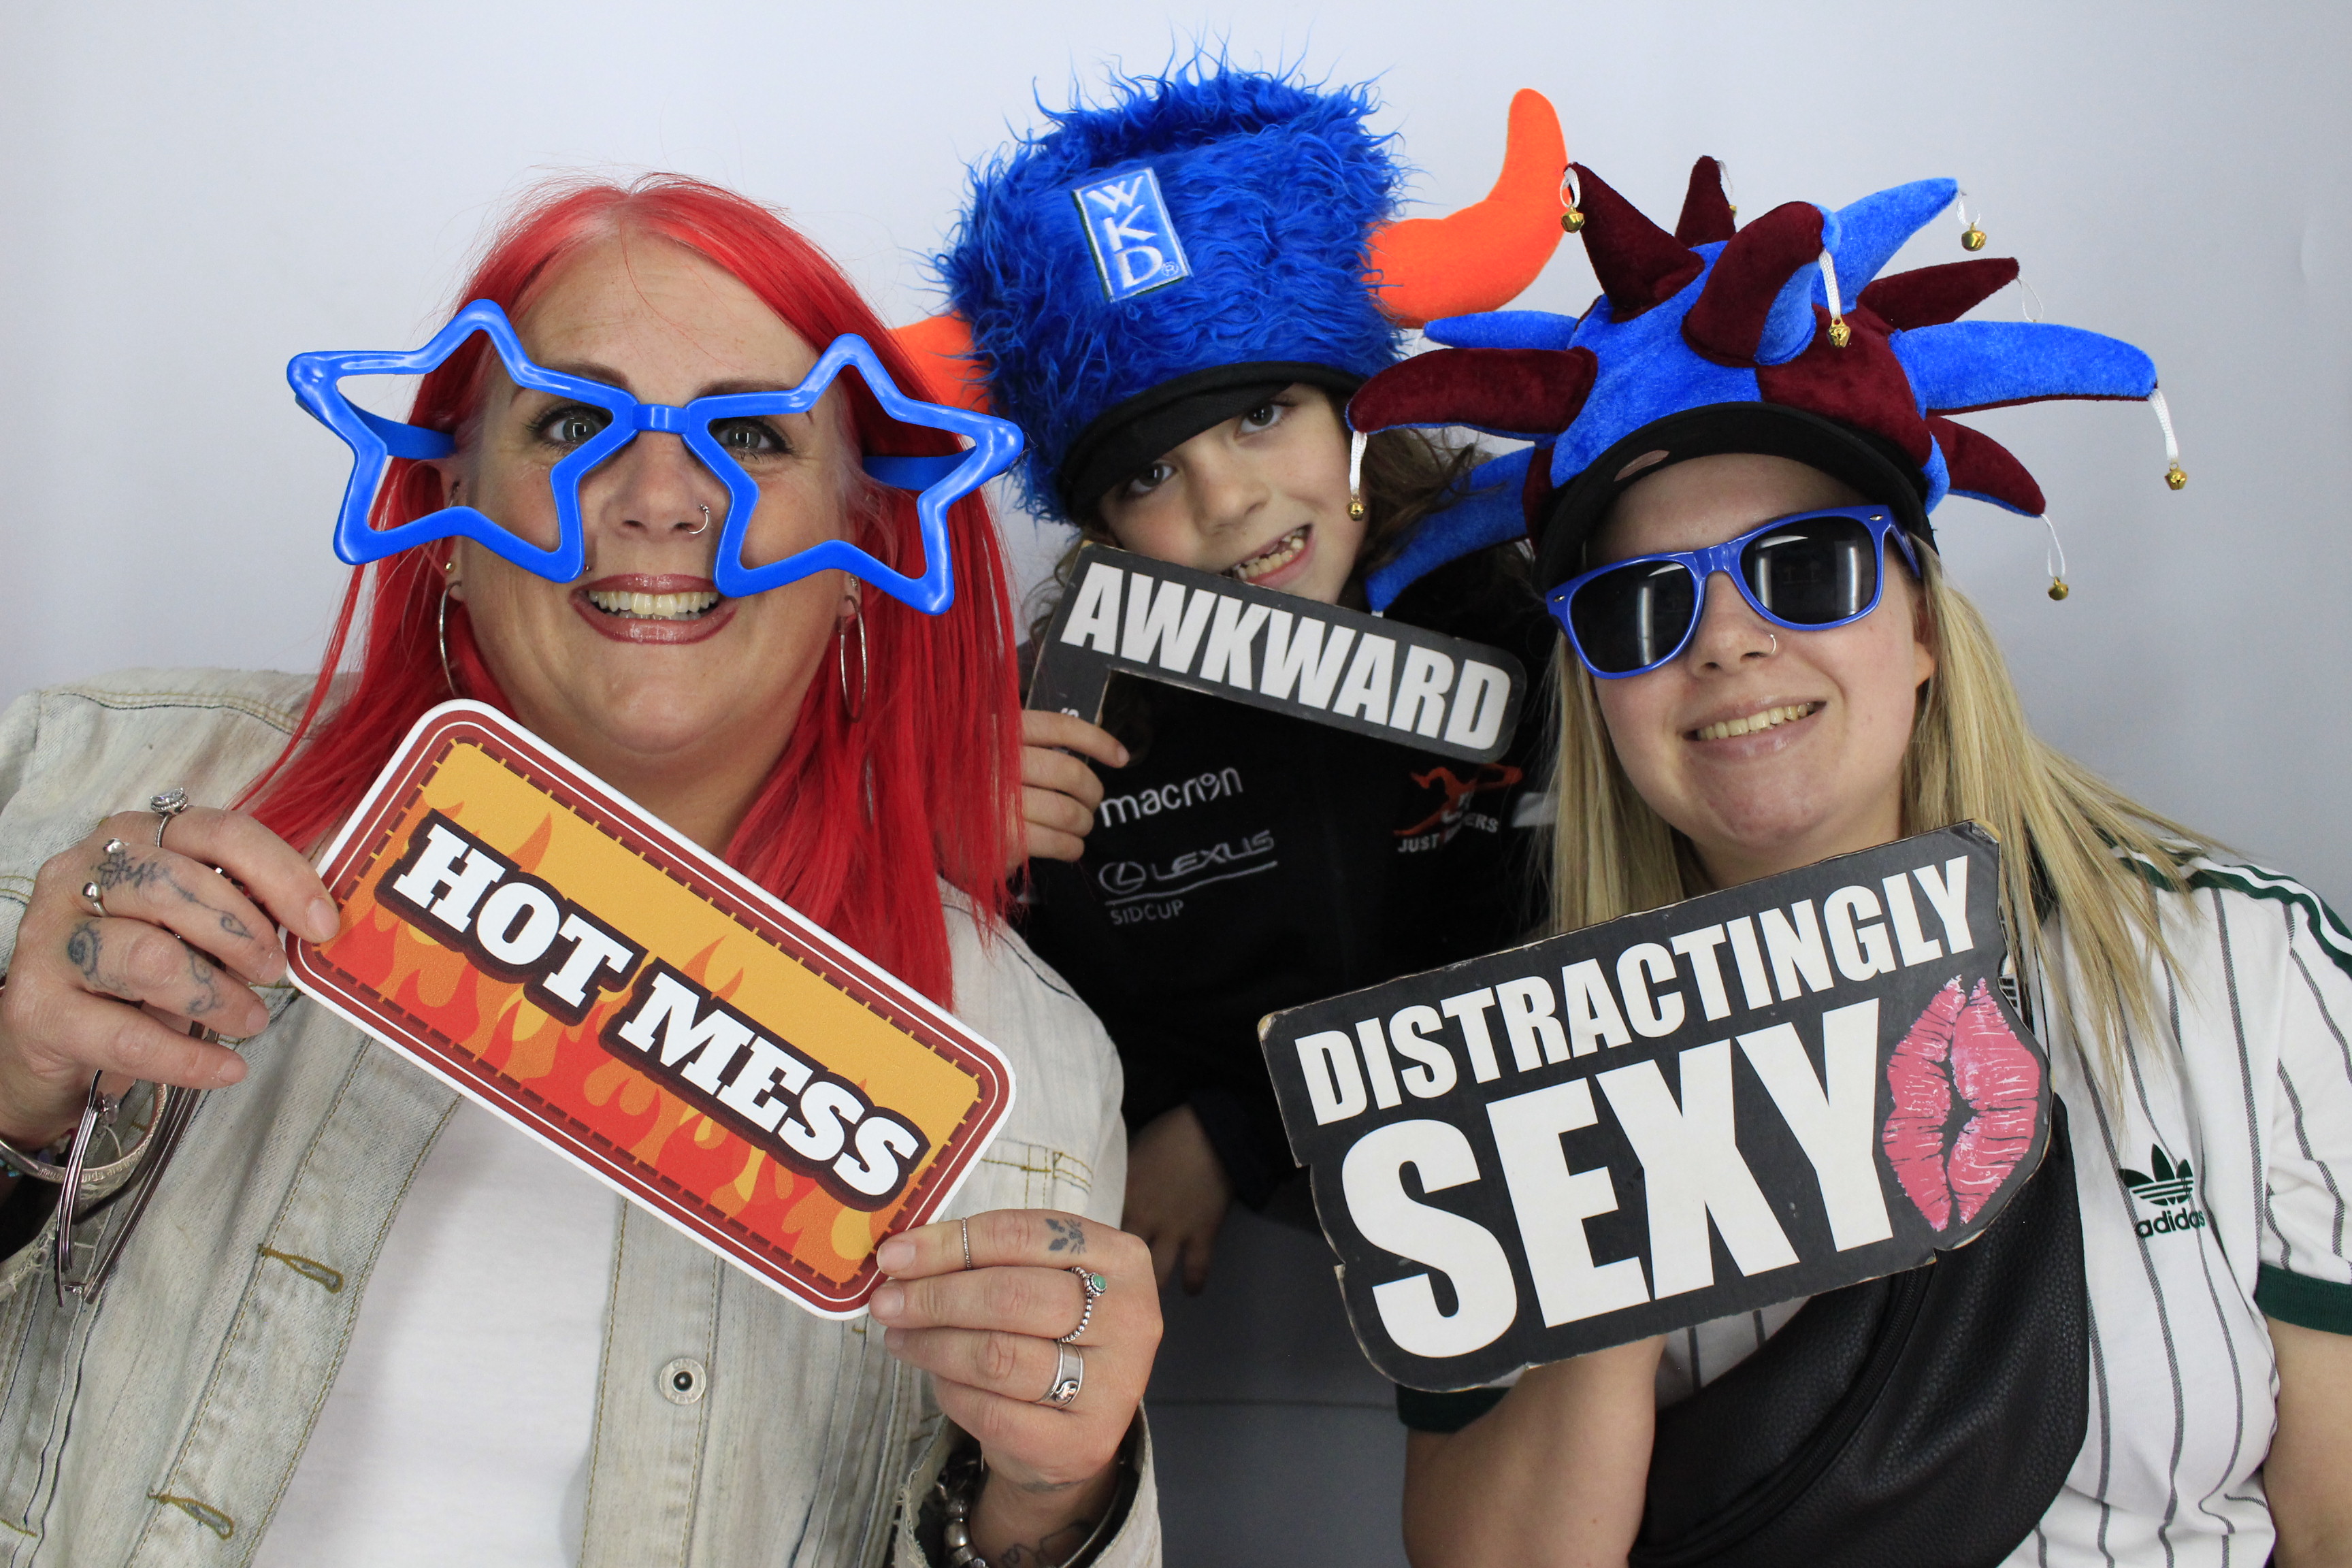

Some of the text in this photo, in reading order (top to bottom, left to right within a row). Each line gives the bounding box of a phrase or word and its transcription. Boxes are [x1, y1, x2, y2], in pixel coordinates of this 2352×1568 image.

[1085, 175, 1164, 290] WKD
[1060, 561, 1512, 751] AWKWARD
[1098, 766, 1244, 828] macron
[1150, 829, 1276, 882] LEXUS
[1396, 832, 1441, 854] JUST
[1110, 898, 1184, 926] SIDCUP
[392, 822, 920, 1196] HOT MESS
[1294, 855, 1974, 1126] DISTRACTINGLY
[1341, 997, 1893, 1358] SEXY
[2134, 1207, 2206, 1239] adidas
